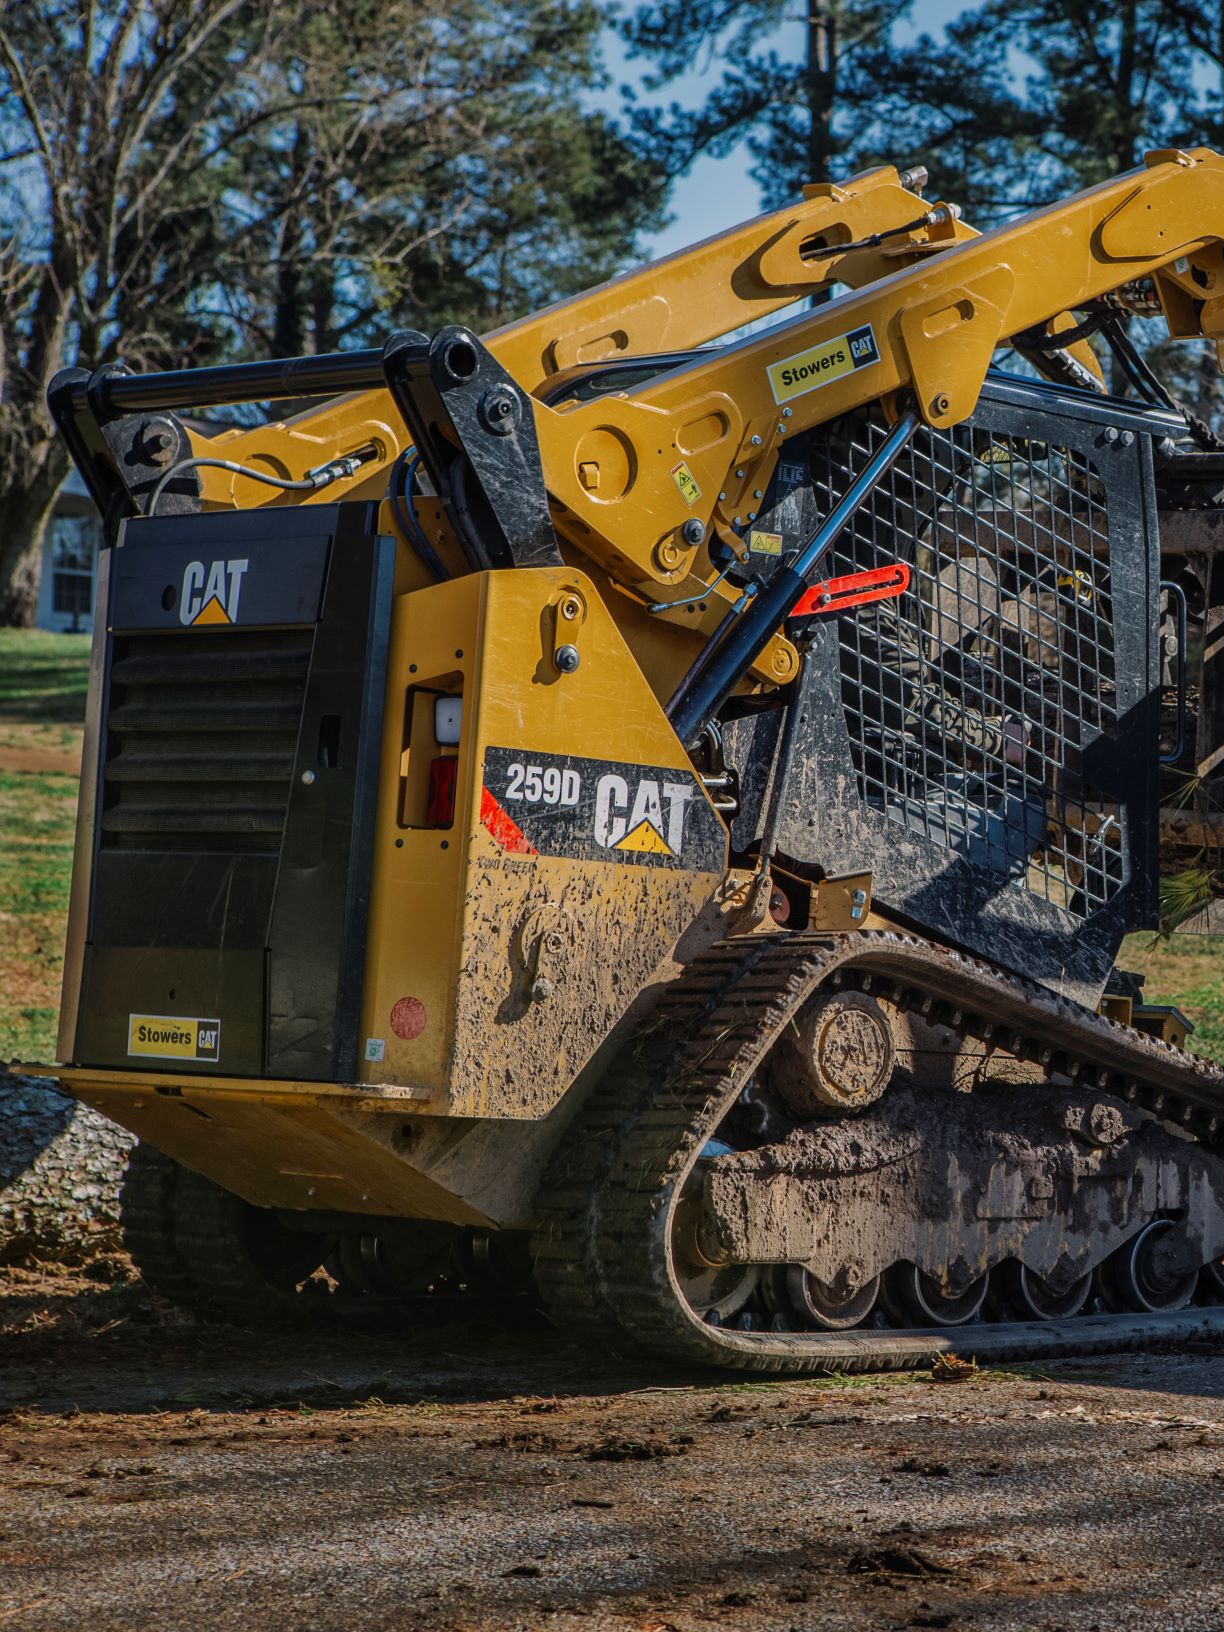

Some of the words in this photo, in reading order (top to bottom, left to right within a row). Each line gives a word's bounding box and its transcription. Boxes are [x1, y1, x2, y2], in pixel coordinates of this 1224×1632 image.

[781, 352, 845, 384] Stowers
[852, 336, 873, 358] CAT
[180, 559, 249, 625] CAT
[505, 763, 580, 805] 259D
[595, 775, 692, 856] CAT
[140, 1027, 191, 1045] Stowers
[200, 1030, 216, 1049] CAT
